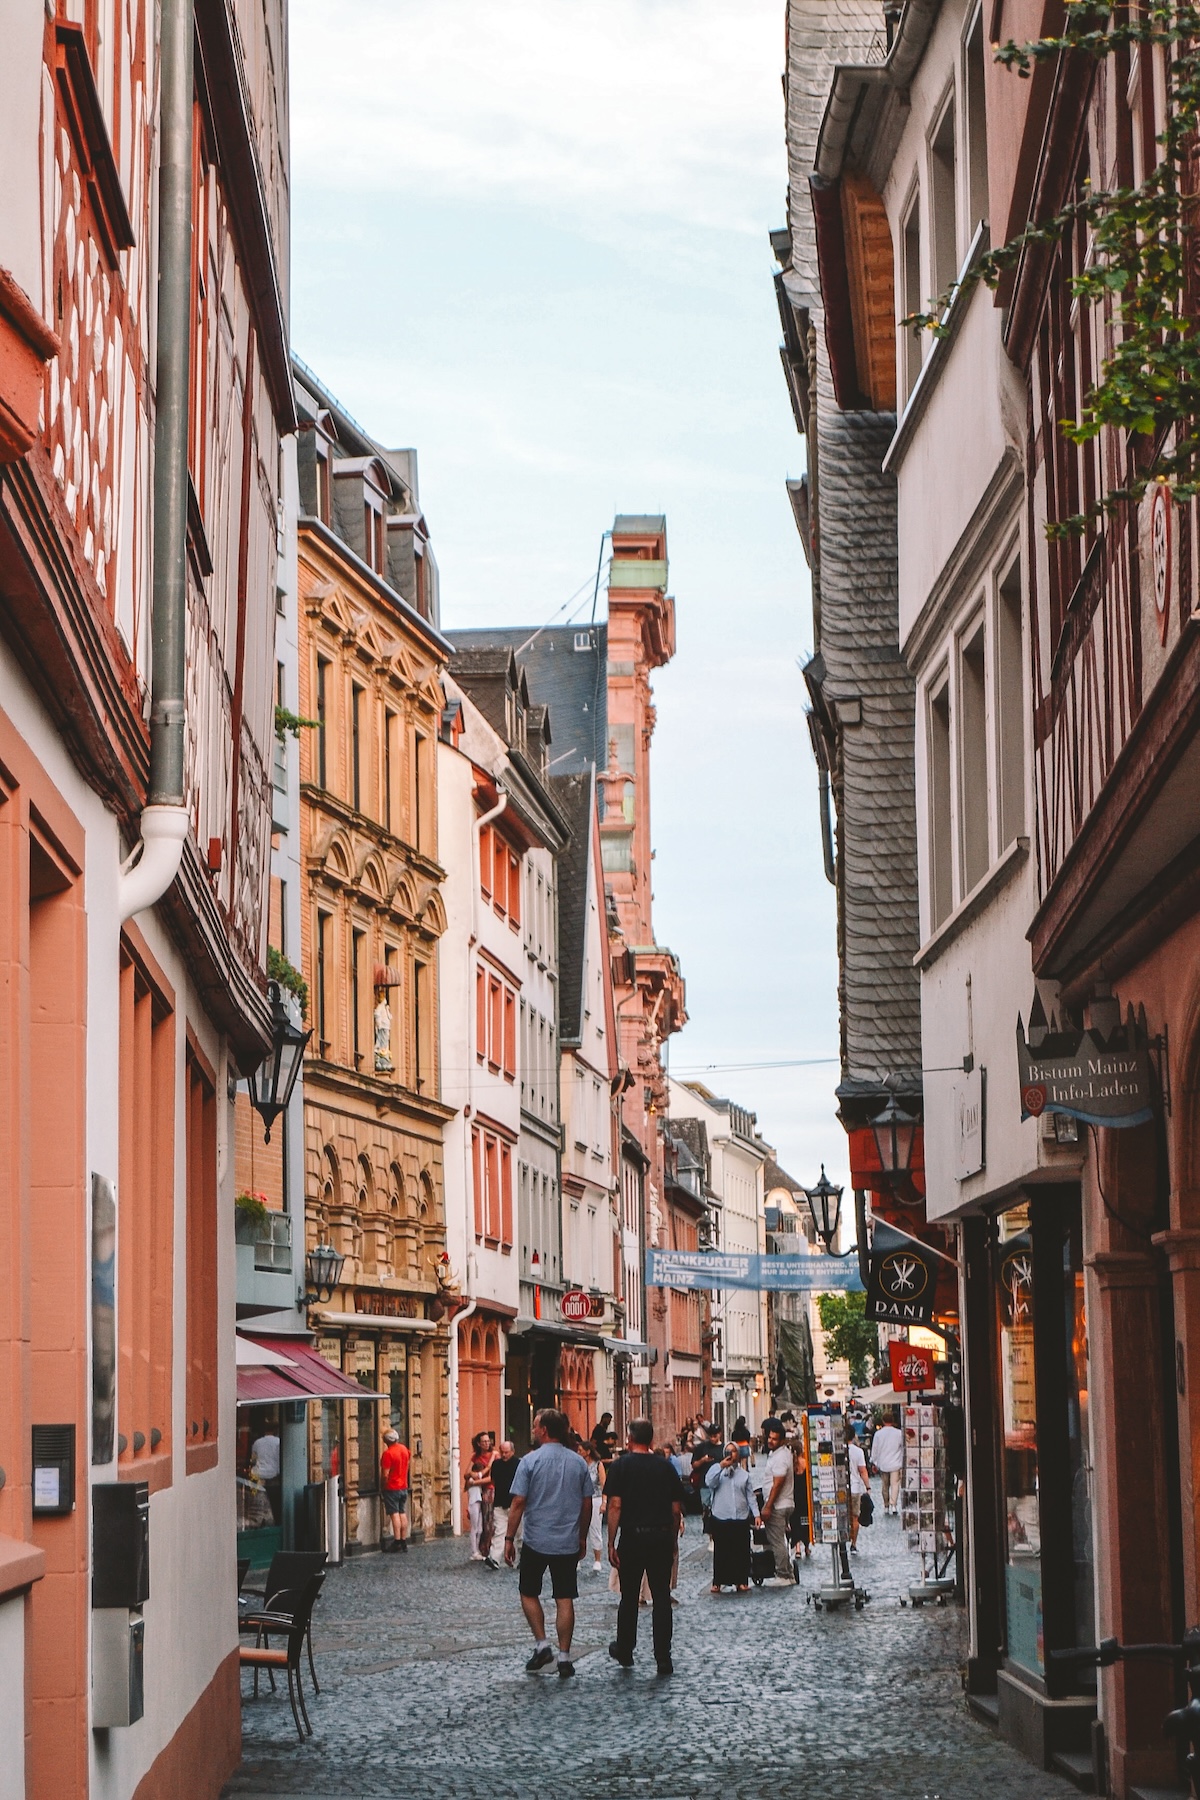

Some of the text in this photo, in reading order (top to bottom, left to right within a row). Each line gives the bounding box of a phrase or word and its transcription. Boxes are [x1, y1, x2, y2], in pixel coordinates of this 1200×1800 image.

[1028, 1057, 1138, 1082] Bistum Mainz
[1052, 1079, 1139, 1102] Info-Laden
[966, 1103, 979, 1132] DANI
[653, 1253, 749, 1268] FRANKFURTER
[653, 1273, 695, 1285] MAINZ
[875, 1301, 924, 1318] DANI
